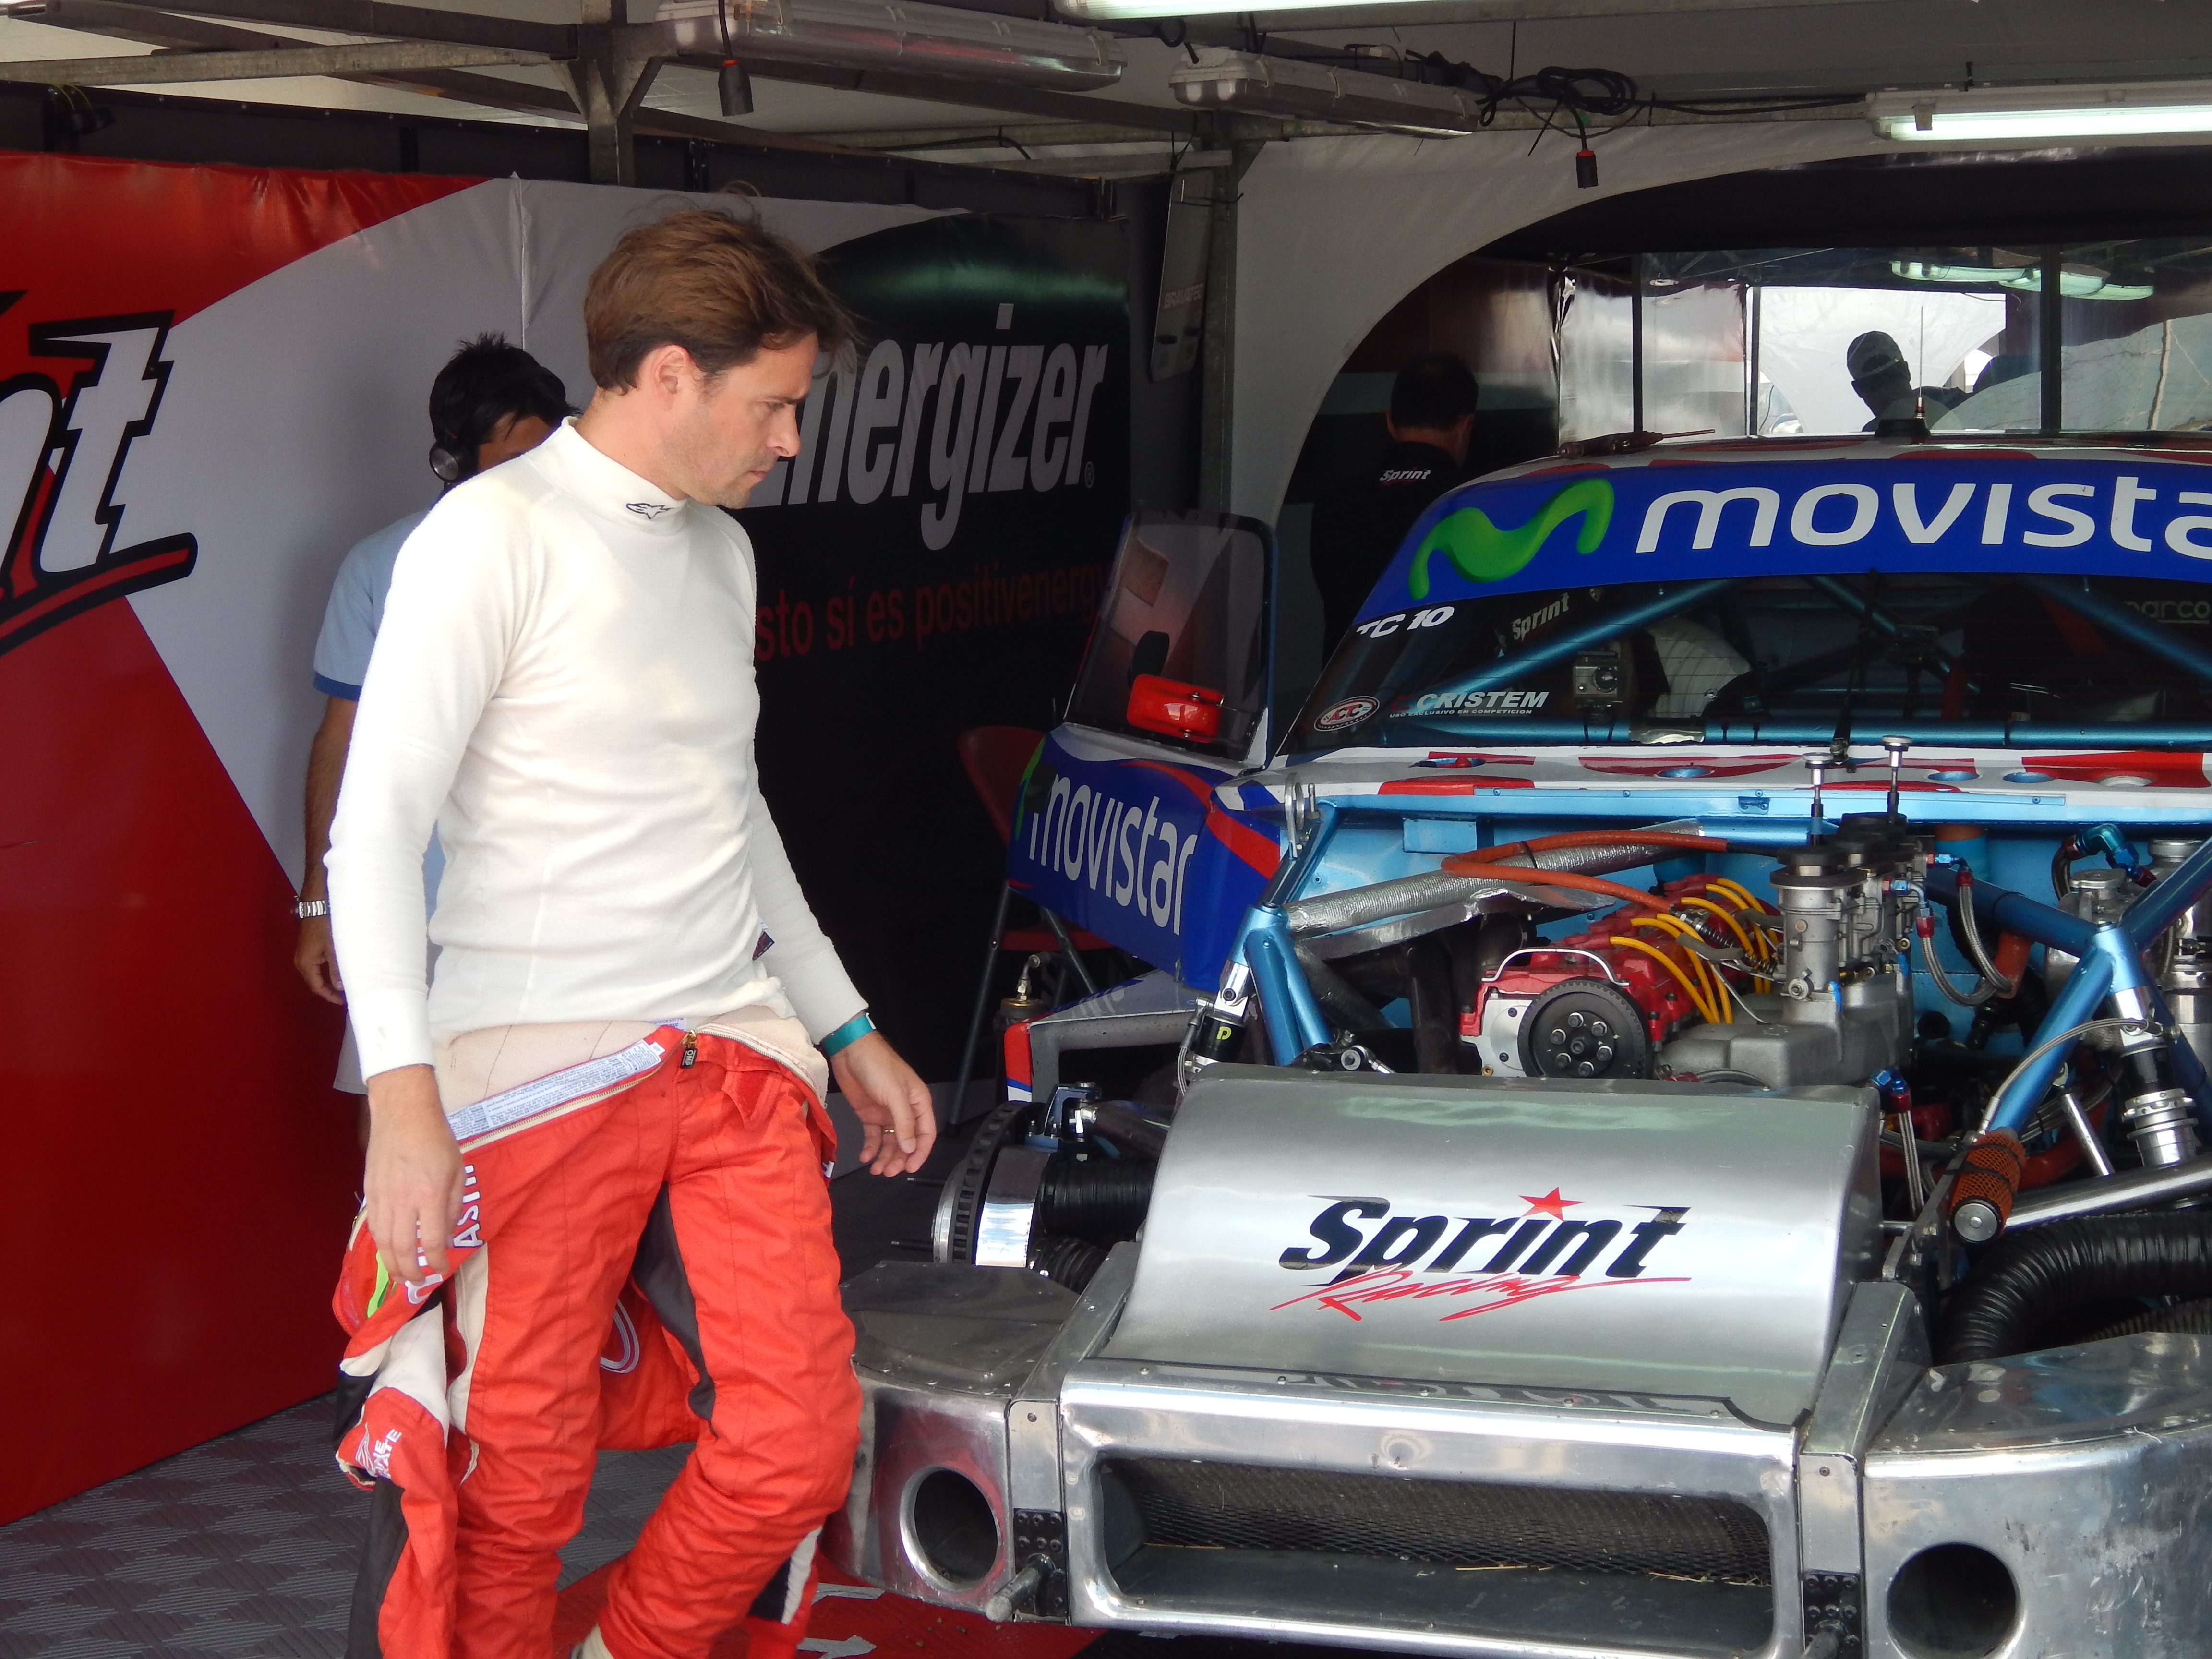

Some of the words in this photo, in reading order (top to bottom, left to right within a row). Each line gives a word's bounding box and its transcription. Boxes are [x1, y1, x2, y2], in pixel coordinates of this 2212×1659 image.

[743, 303, 1108, 551] nergizer
[1379, 469, 1431, 482] Sprint
[755, 589, 814, 661] sto
[826, 575, 856, 650] sí
[866, 589, 905, 643] es
[1356, 614, 1406, 638] TC
[1407, 606, 1455, 630] 10
[1511, 591, 1570, 642] Sprint
[1416, 691, 1549, 708] CRISTEM
[684, 1049, 694, 1066] OMP
[1278, 1194, 1692, 1287] Sprint
